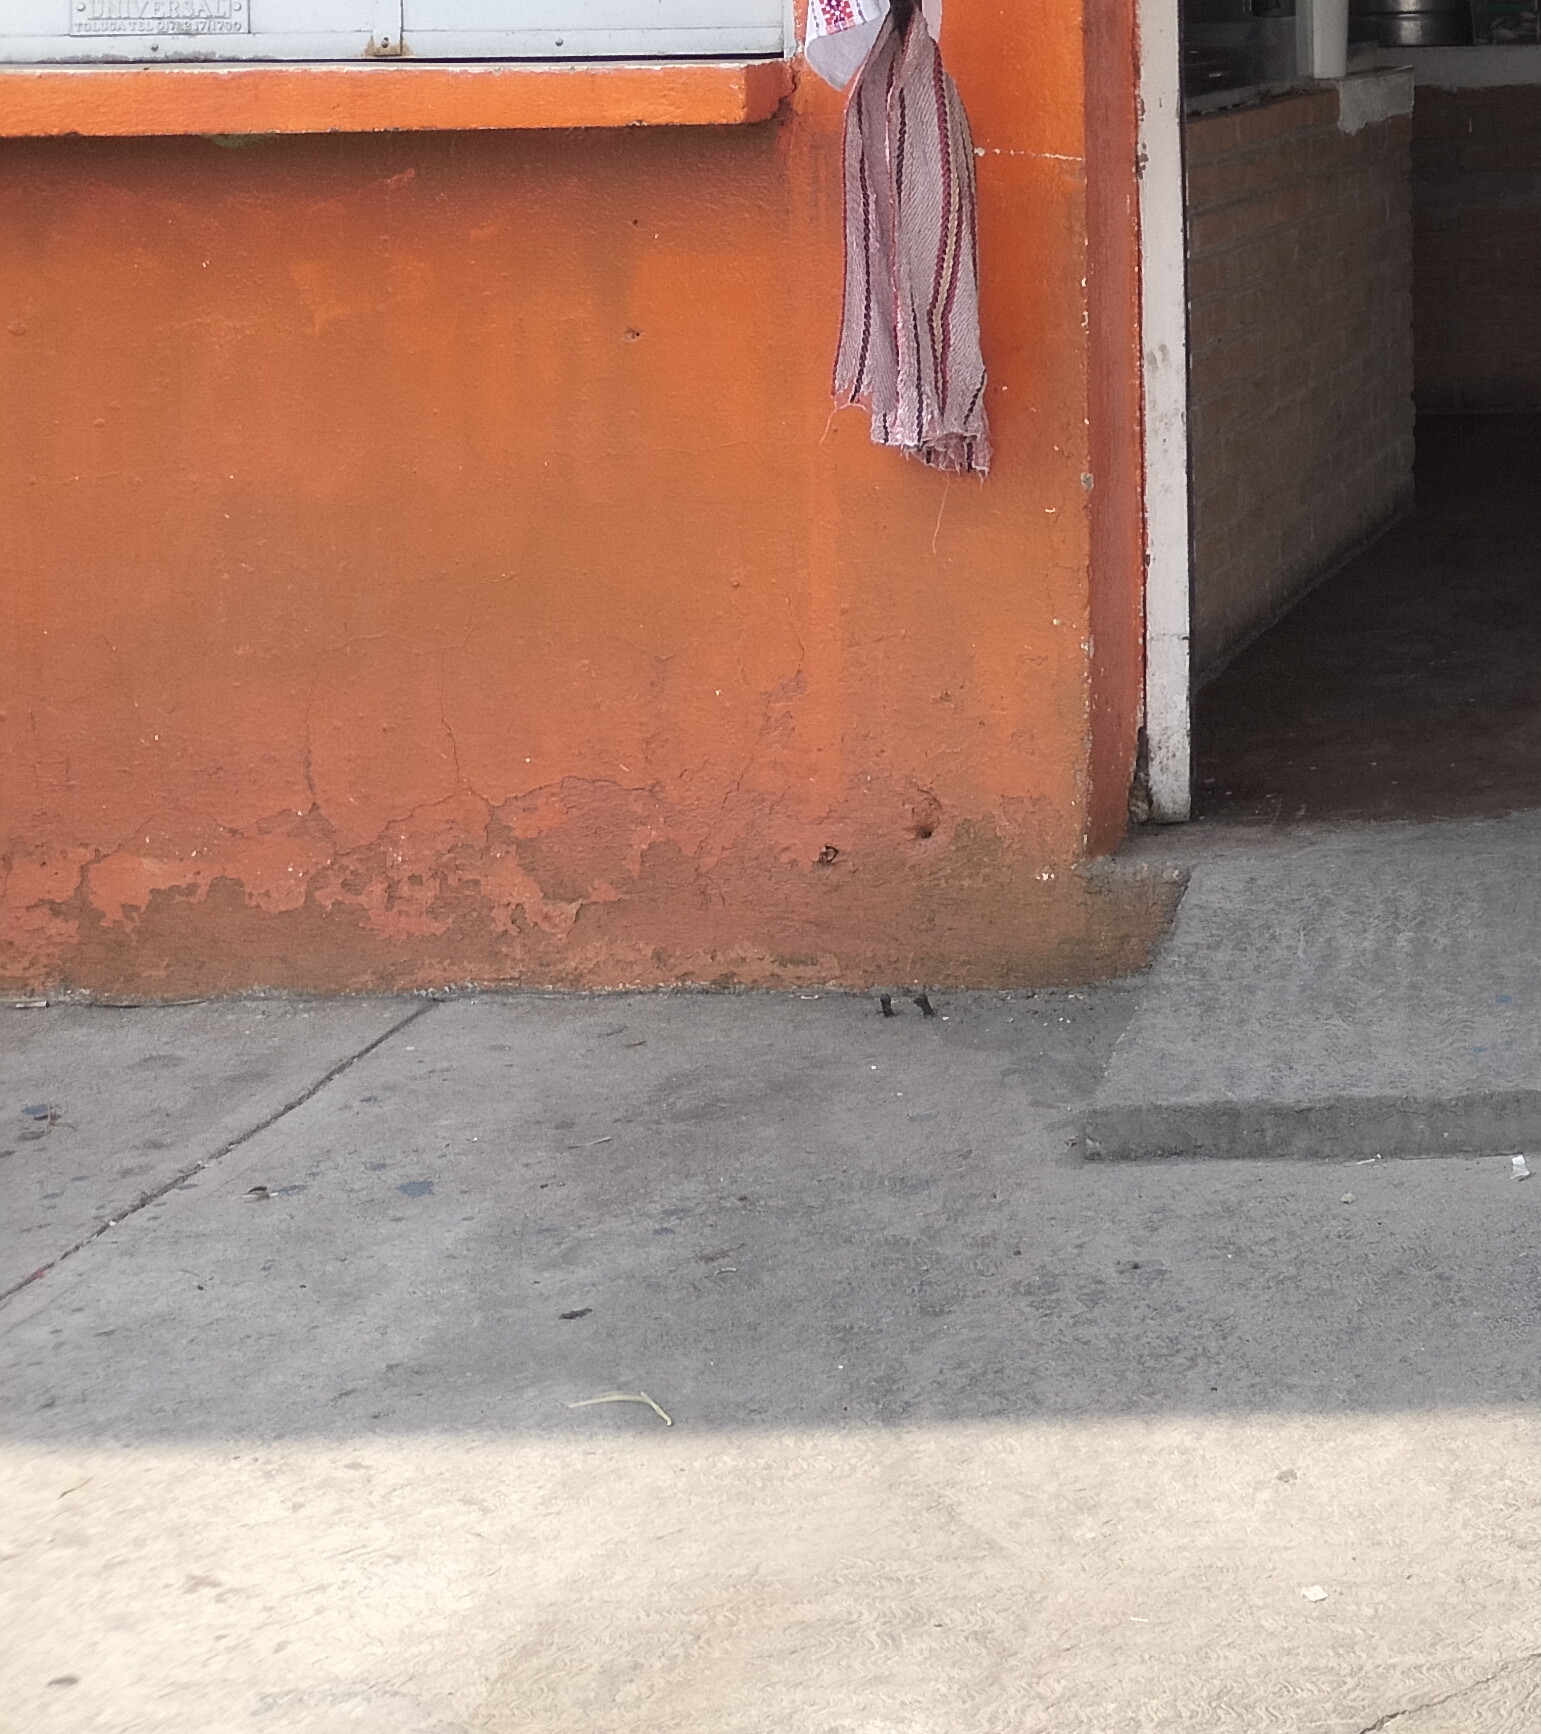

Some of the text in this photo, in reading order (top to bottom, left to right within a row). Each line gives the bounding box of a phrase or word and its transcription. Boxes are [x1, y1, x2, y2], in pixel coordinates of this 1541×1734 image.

[89, 0, 229, 18] UNIVERSAL
[73, 22, 127, 33] TOLUCA
[128, 21, 156, 32] TEL
